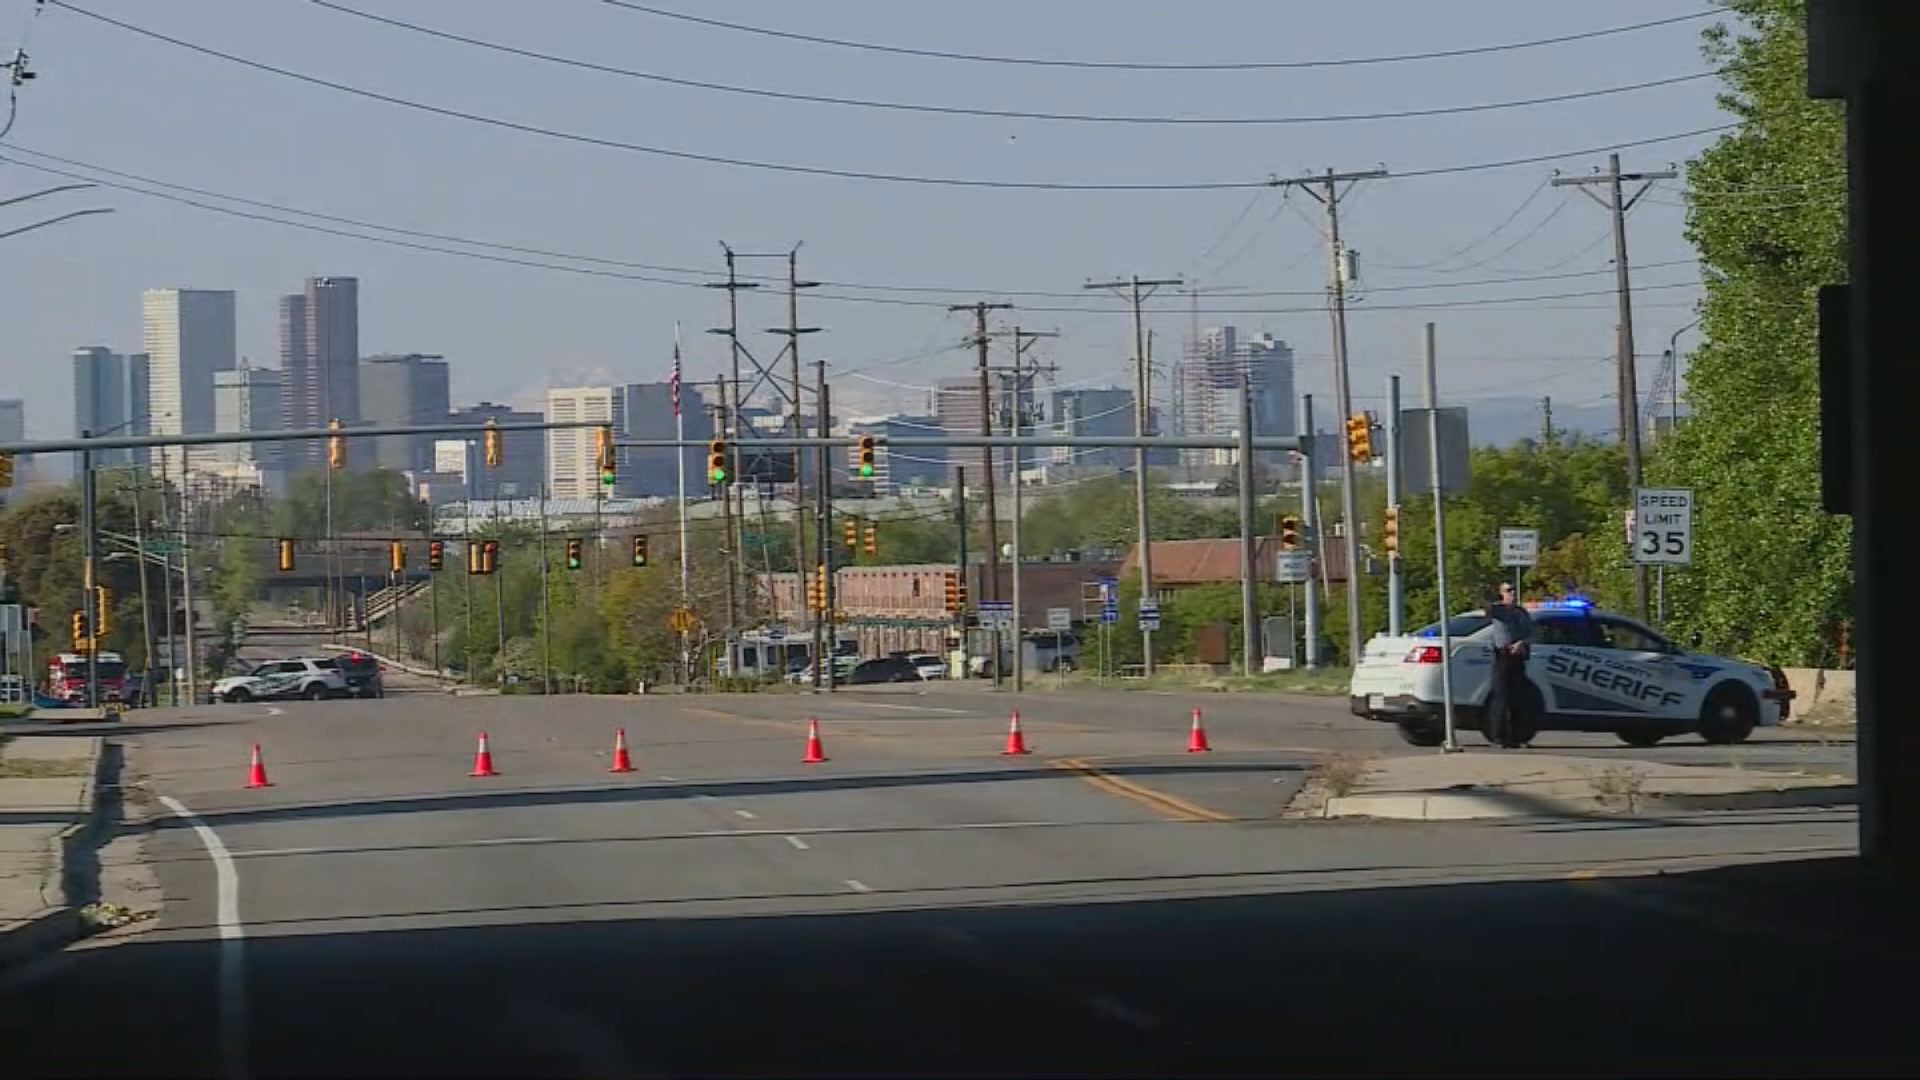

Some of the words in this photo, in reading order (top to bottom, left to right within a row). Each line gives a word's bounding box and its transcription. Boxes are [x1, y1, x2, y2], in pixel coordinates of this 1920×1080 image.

[1640, 495, 1688, 507] SPEED
[1645, 513, 1682, 525] LIMIT
[1643, 530, 1684, 554] 35
[1604, 660, 1653, 677] COUNTY
[1546, 655, 1685, 706] SHERIFF
